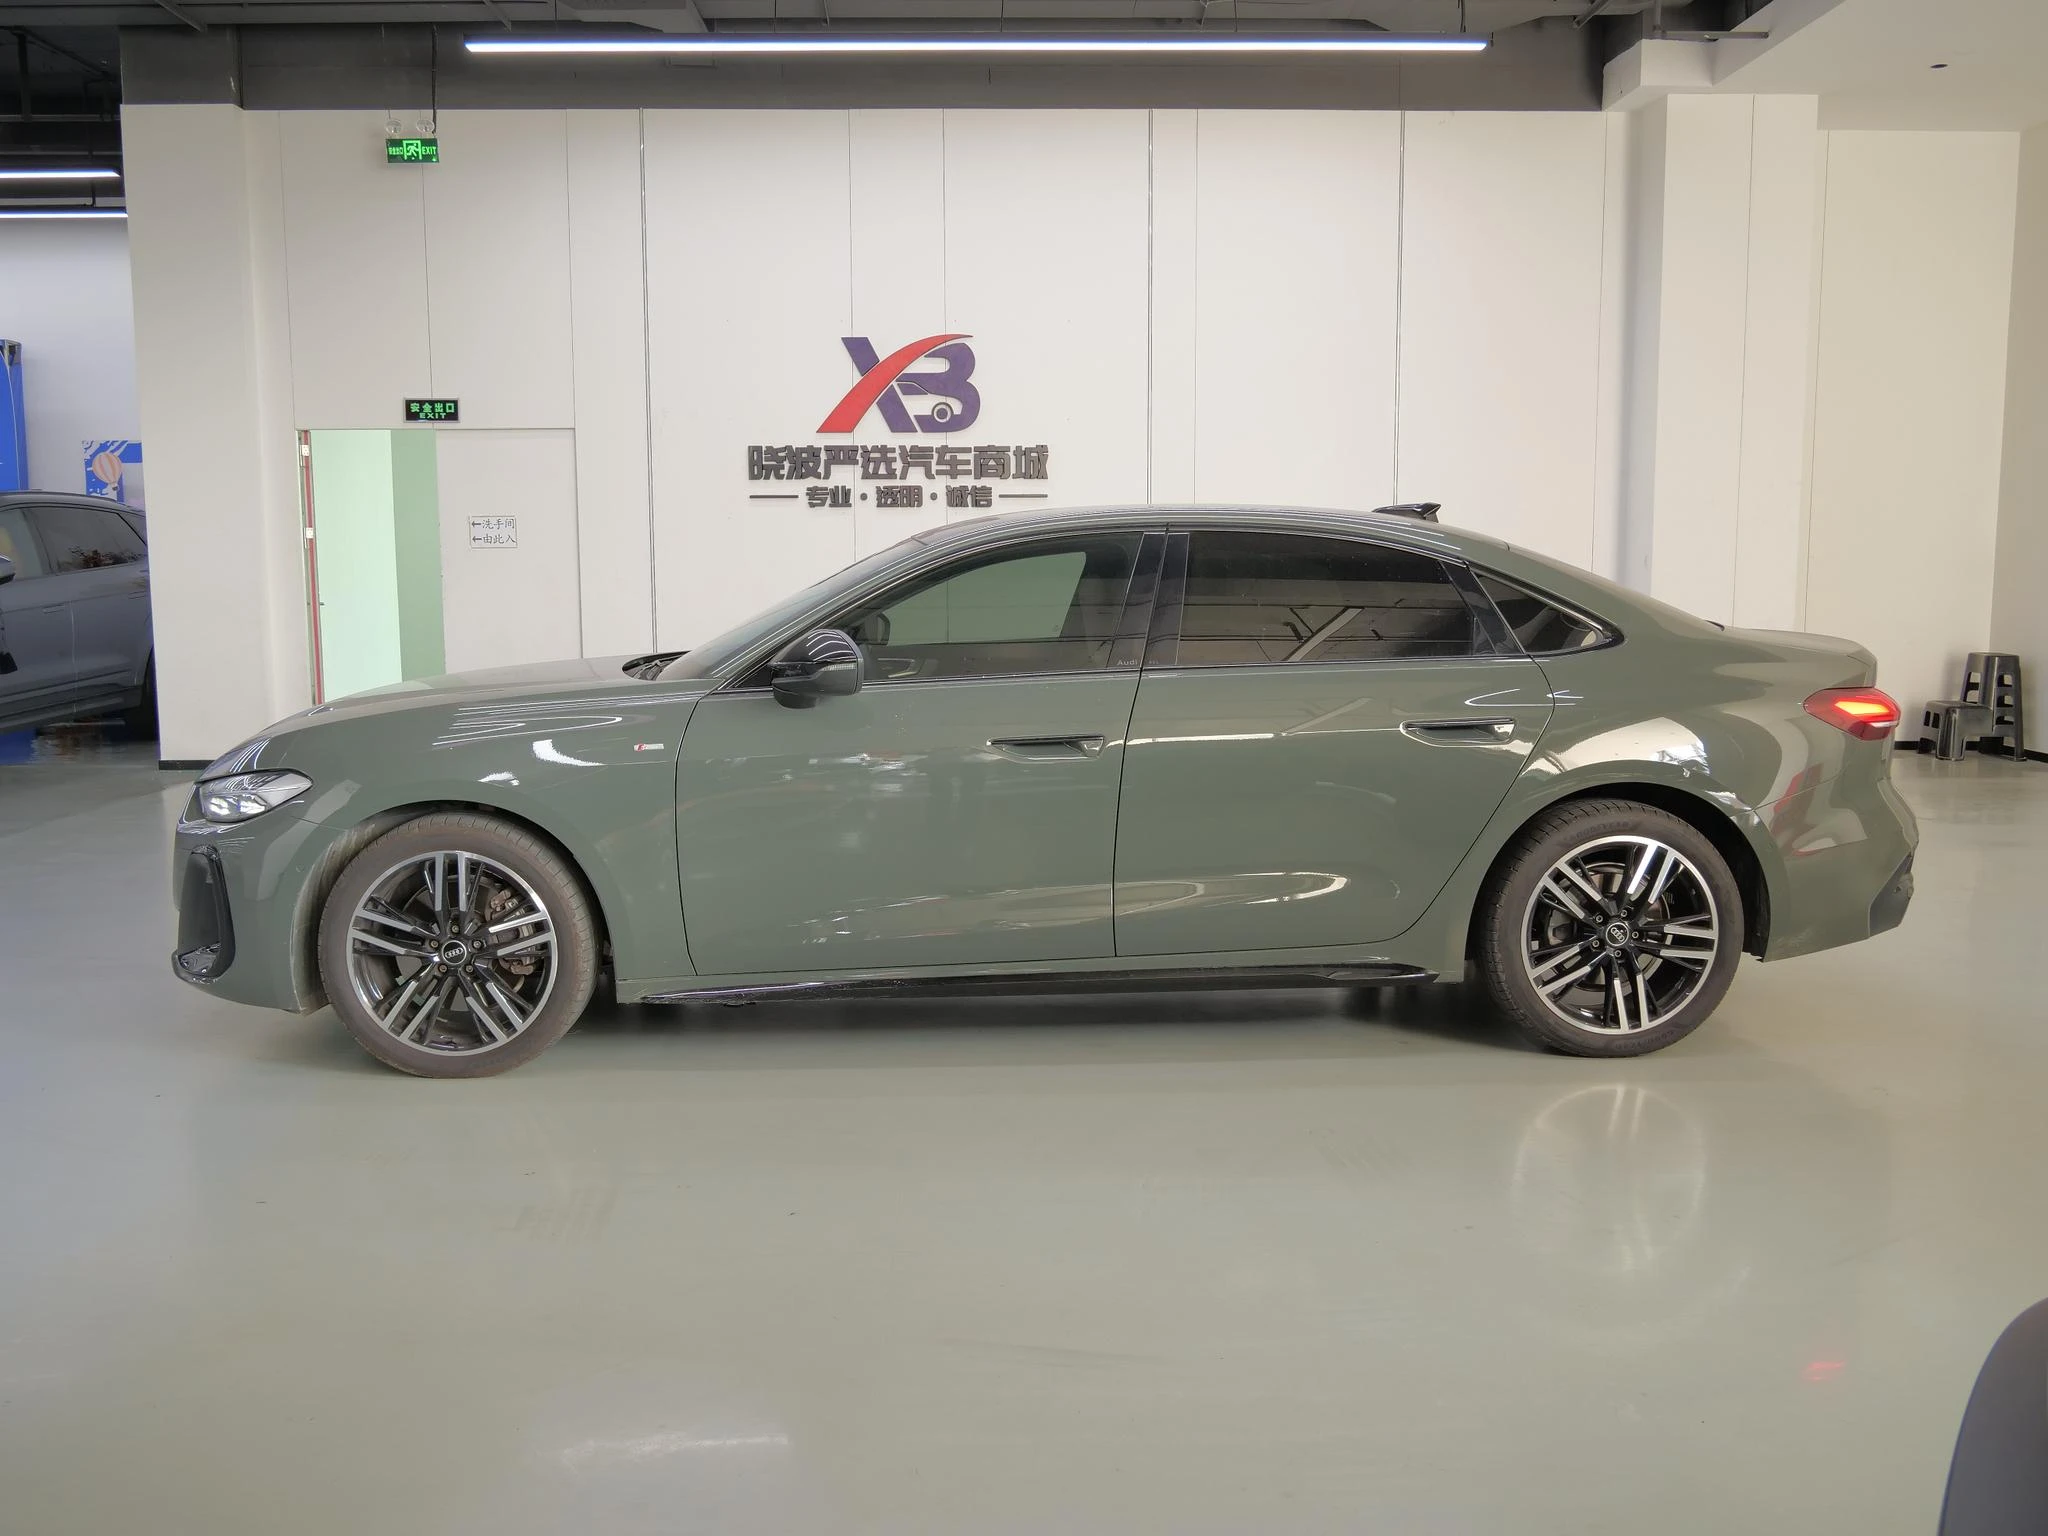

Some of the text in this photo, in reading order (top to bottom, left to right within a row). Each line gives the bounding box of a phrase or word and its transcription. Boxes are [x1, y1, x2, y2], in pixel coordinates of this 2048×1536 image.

[422, 146, 436, 155] EXIT
[410, 402, 455, 413] 安全出口
[748, 445, 1049, 481] 晓波严选汽车商城
[482, 518, 515, 530] 洗手间
[482, 533, 517, 544] 由此入
[1117, 658, 1138, 666] Audi
